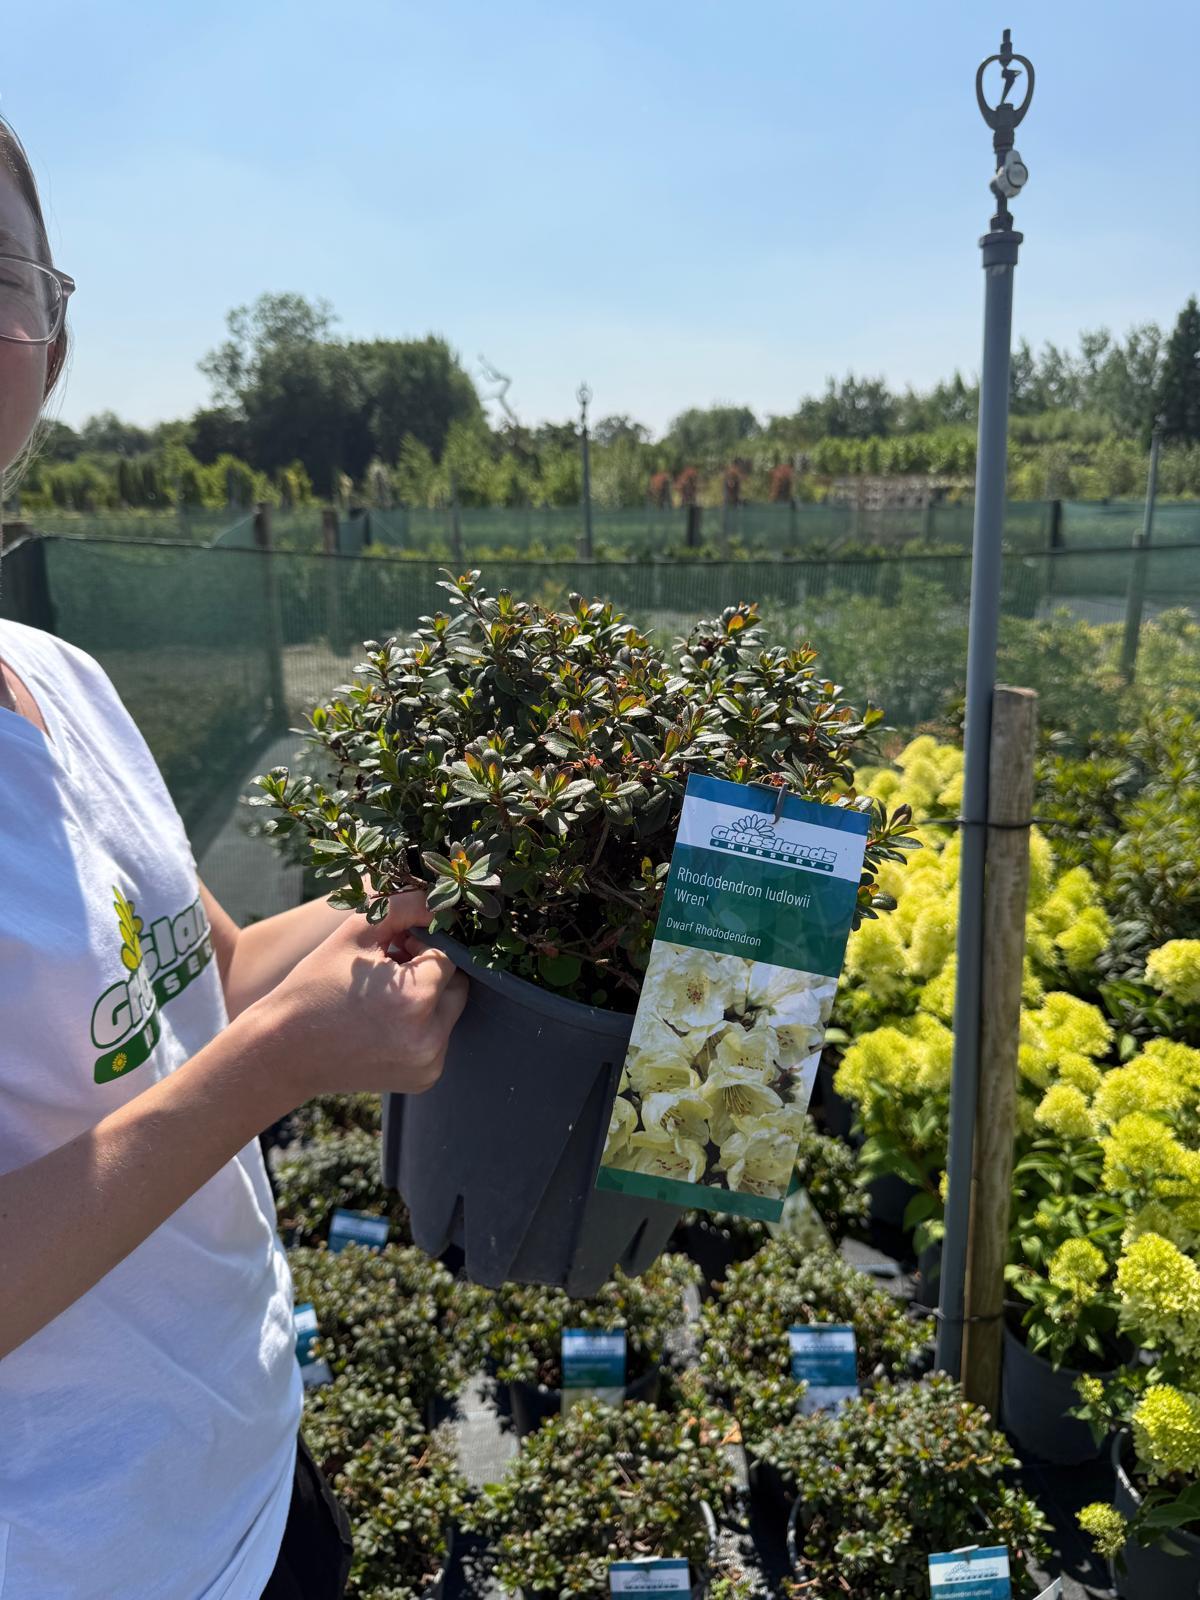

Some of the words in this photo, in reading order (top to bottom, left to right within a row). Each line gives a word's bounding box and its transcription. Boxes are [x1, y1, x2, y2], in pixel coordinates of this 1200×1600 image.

[711, 825, 837, 864] Grasslands
[727, 843, 817, 867] NURSERY
[674, 887, 710, 907] 'Wren'
[677, 866, 762, 898] Rhododendron
[765, 886, 811, 908] ludlowii
[666, 916, 694, 932] Dwarf
[695, 923, 762, 947] Rhododendron
